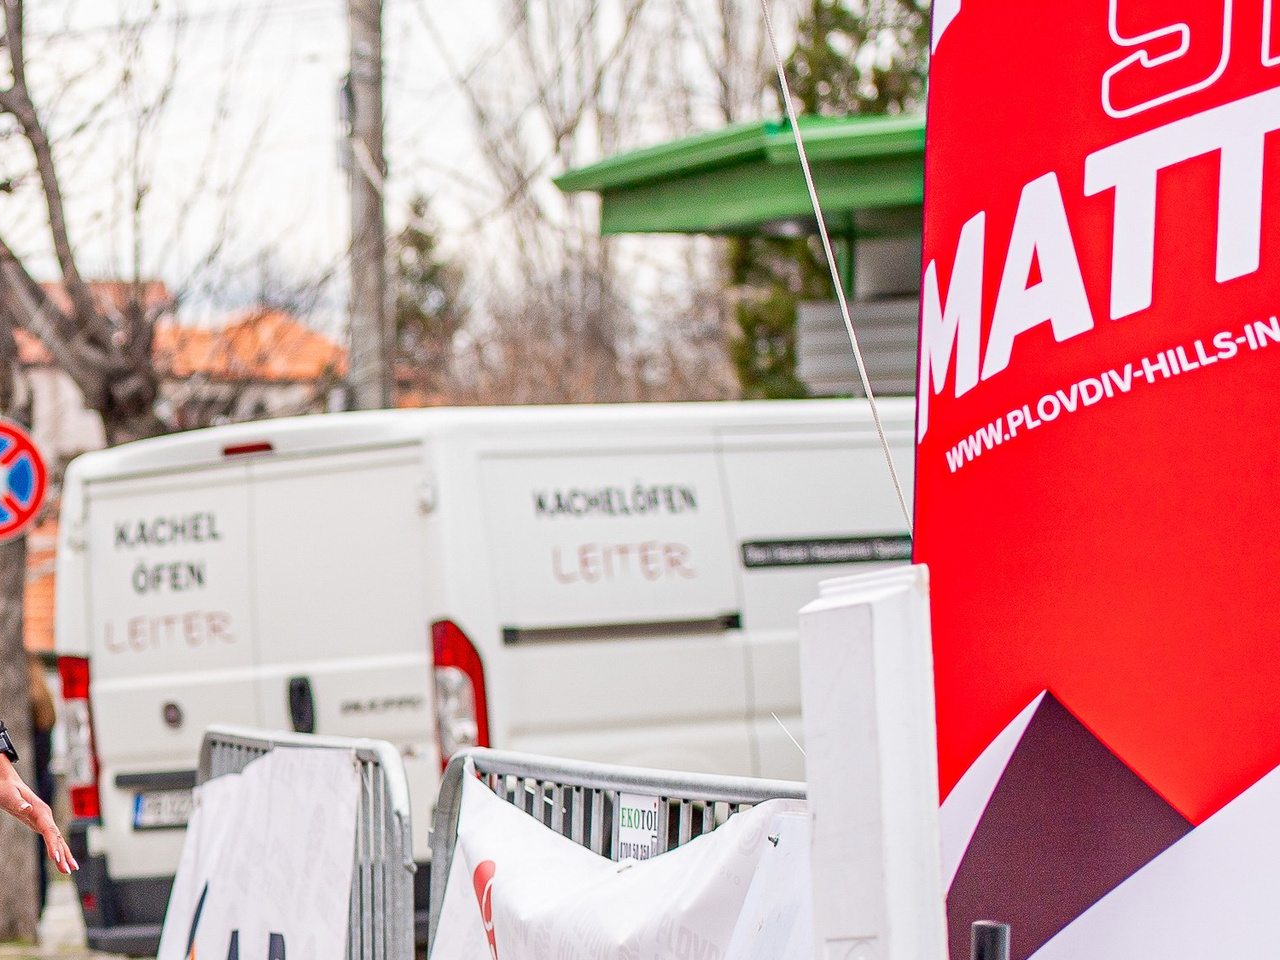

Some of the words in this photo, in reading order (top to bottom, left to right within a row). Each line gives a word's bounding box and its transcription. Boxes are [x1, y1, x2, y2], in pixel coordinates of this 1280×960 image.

[1101, 0, 1280, 118] S
[114, 512, 222, 549] KACHEL
[551, 539, 697, 585] LEITER
[103, 610, 238, 654] LEITER
